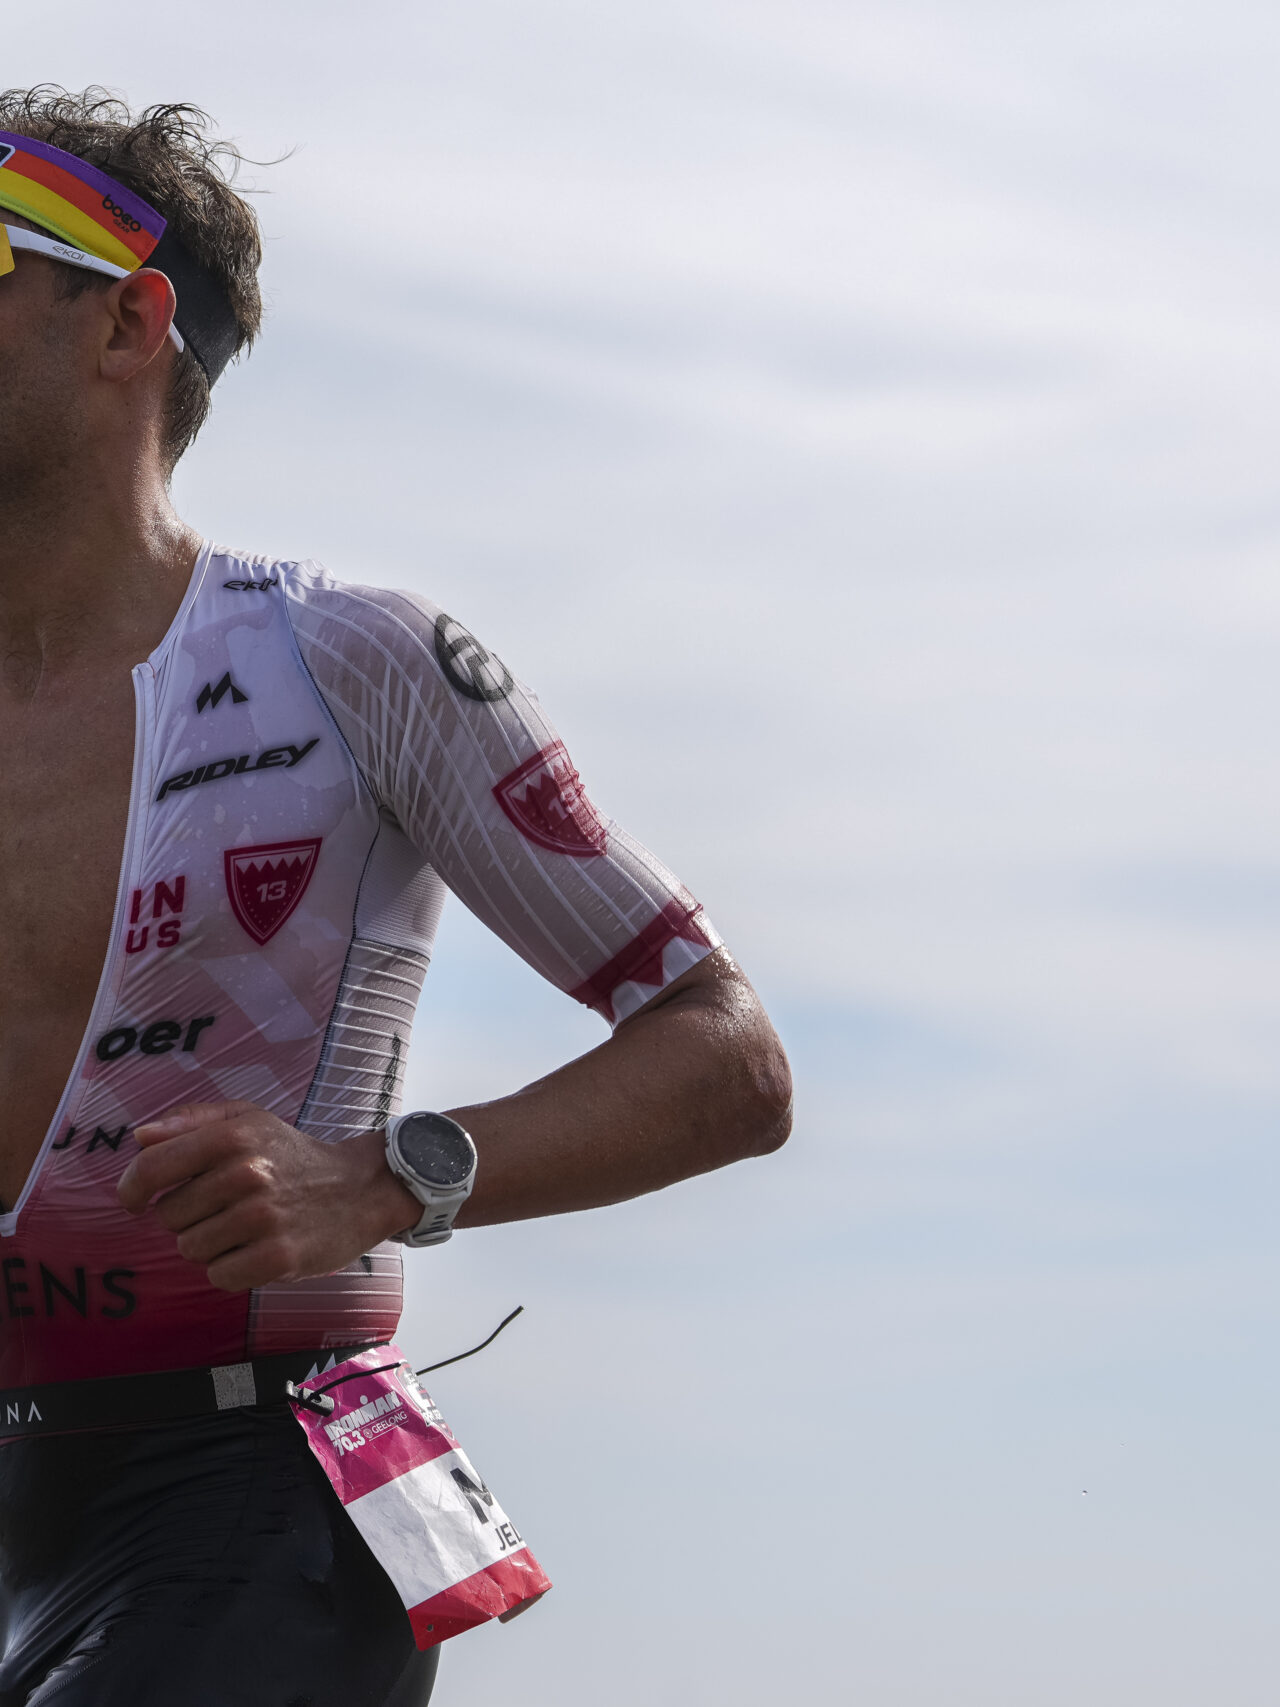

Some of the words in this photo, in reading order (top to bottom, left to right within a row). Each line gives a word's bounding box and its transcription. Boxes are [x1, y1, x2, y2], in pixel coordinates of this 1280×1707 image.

[156, 738, 320, 802] RIDLEY
[129, 875, 186, 924] IN
[256, 880, 287, 903] 13
[125, 919, 182, 954] US
[96, 1016, 216, 1061] oer
[323, 1390, 402, 1442] IRONMAN
[333, 1430, 366, 1457] 70.3
[371, 1411, 408, 1434] GEELONG
